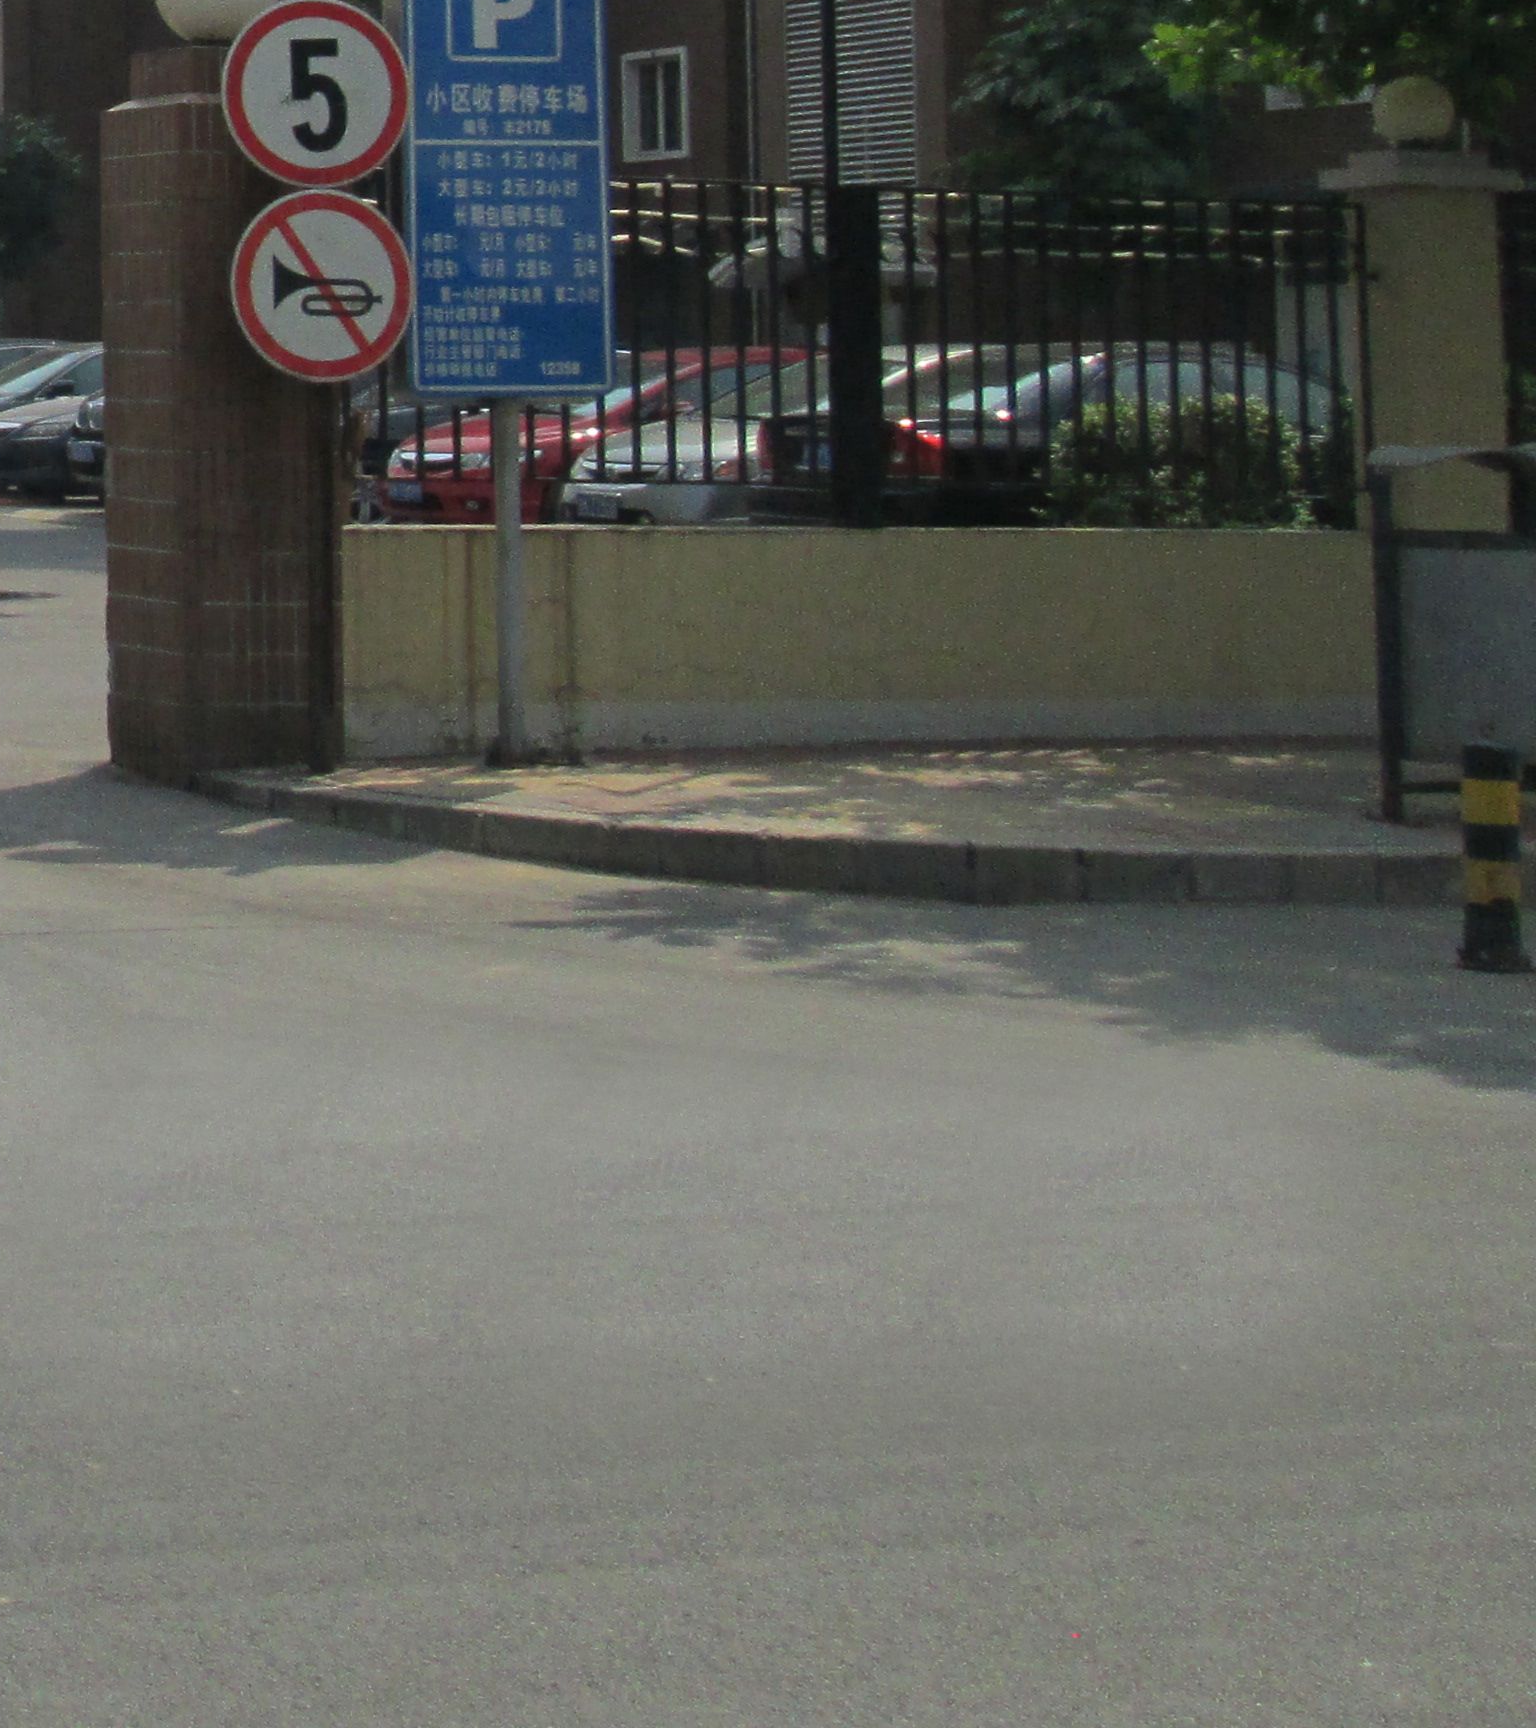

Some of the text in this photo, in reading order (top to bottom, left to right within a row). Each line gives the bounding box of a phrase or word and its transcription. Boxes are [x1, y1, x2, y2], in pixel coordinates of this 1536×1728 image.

[290, 37, 348, 153] 5
[426, 83, 588, 114] 小区收费停车场
